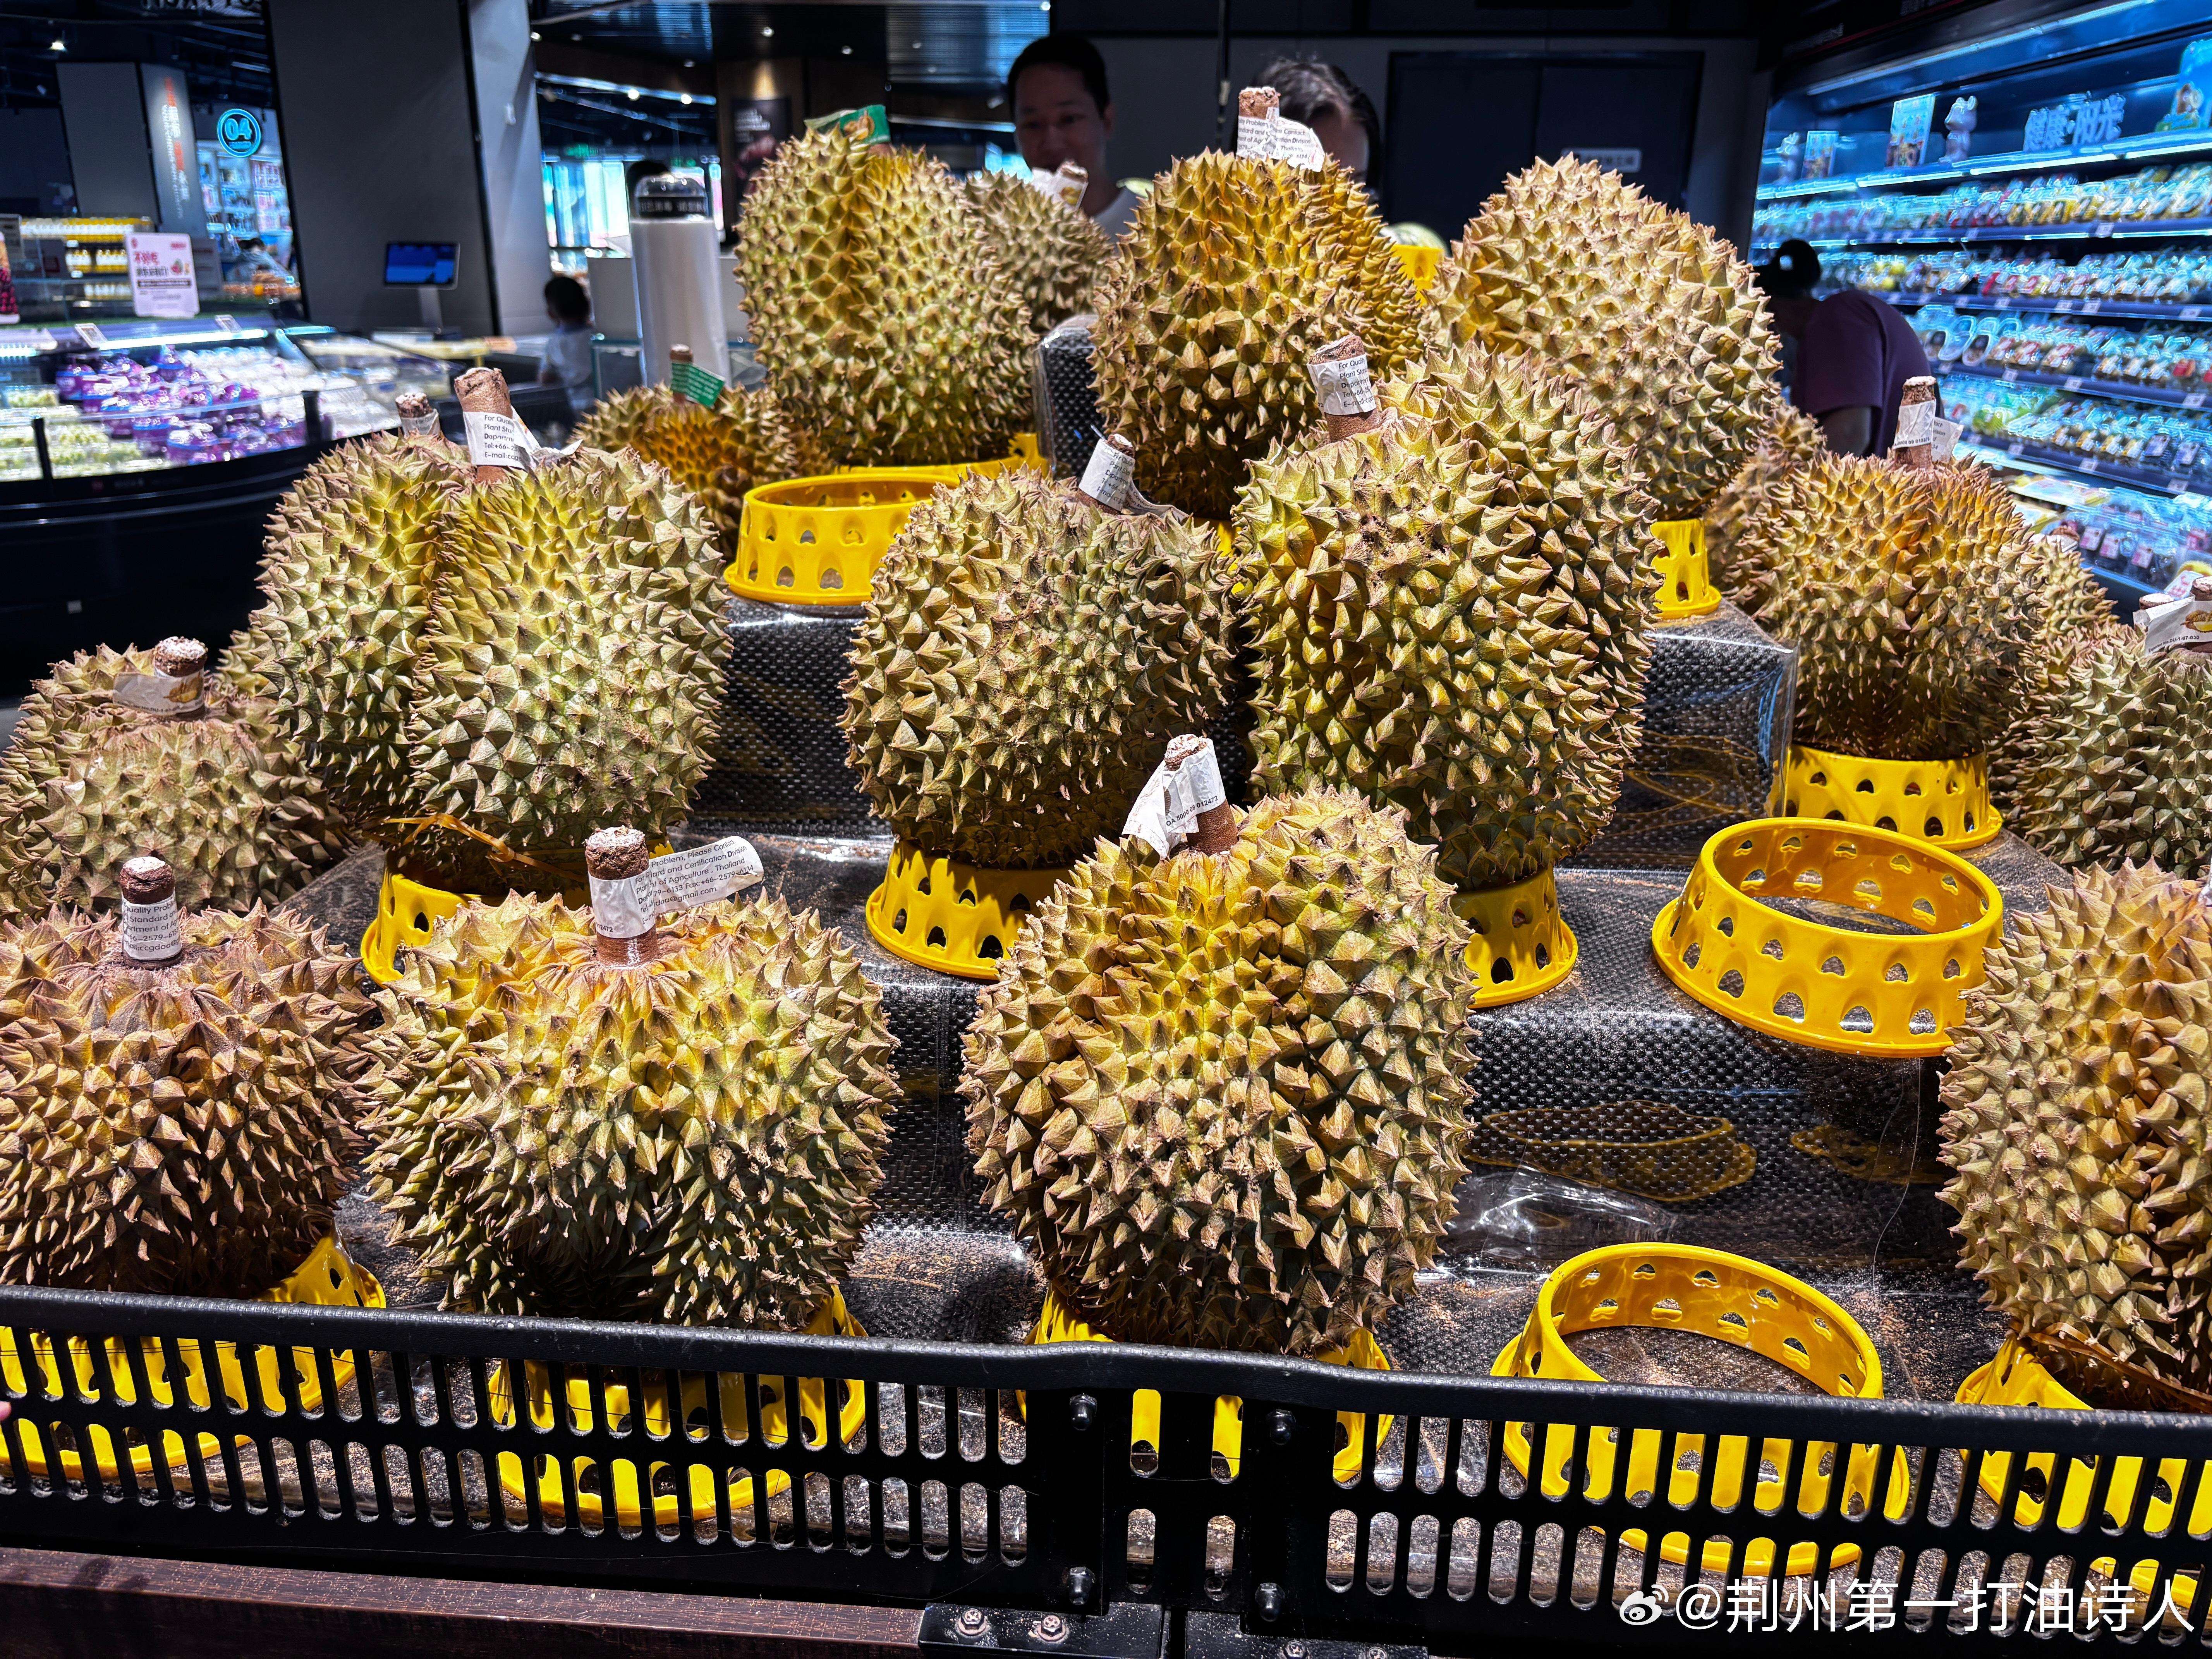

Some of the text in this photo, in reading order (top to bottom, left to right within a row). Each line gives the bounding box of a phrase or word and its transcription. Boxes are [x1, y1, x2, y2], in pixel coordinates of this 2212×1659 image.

[225, 118, 252, 140] 04
[1340, 370, 1355, 379] Plant
[1196, 795, 1218, 808] 012472
[651, 855, 685, 868] Problem,
[688, 848, 712, 859] Please
[667, 864, 682, 873] and
[684, 855, 727, 869] Certification
[728, 845, 747, 857] Division
[668, 870, 709, 883] Agriculture
[715, 857, 745, 871] Thailand
[635, 876, 644, 884] For
[130, 914, 168, 922] Standard
